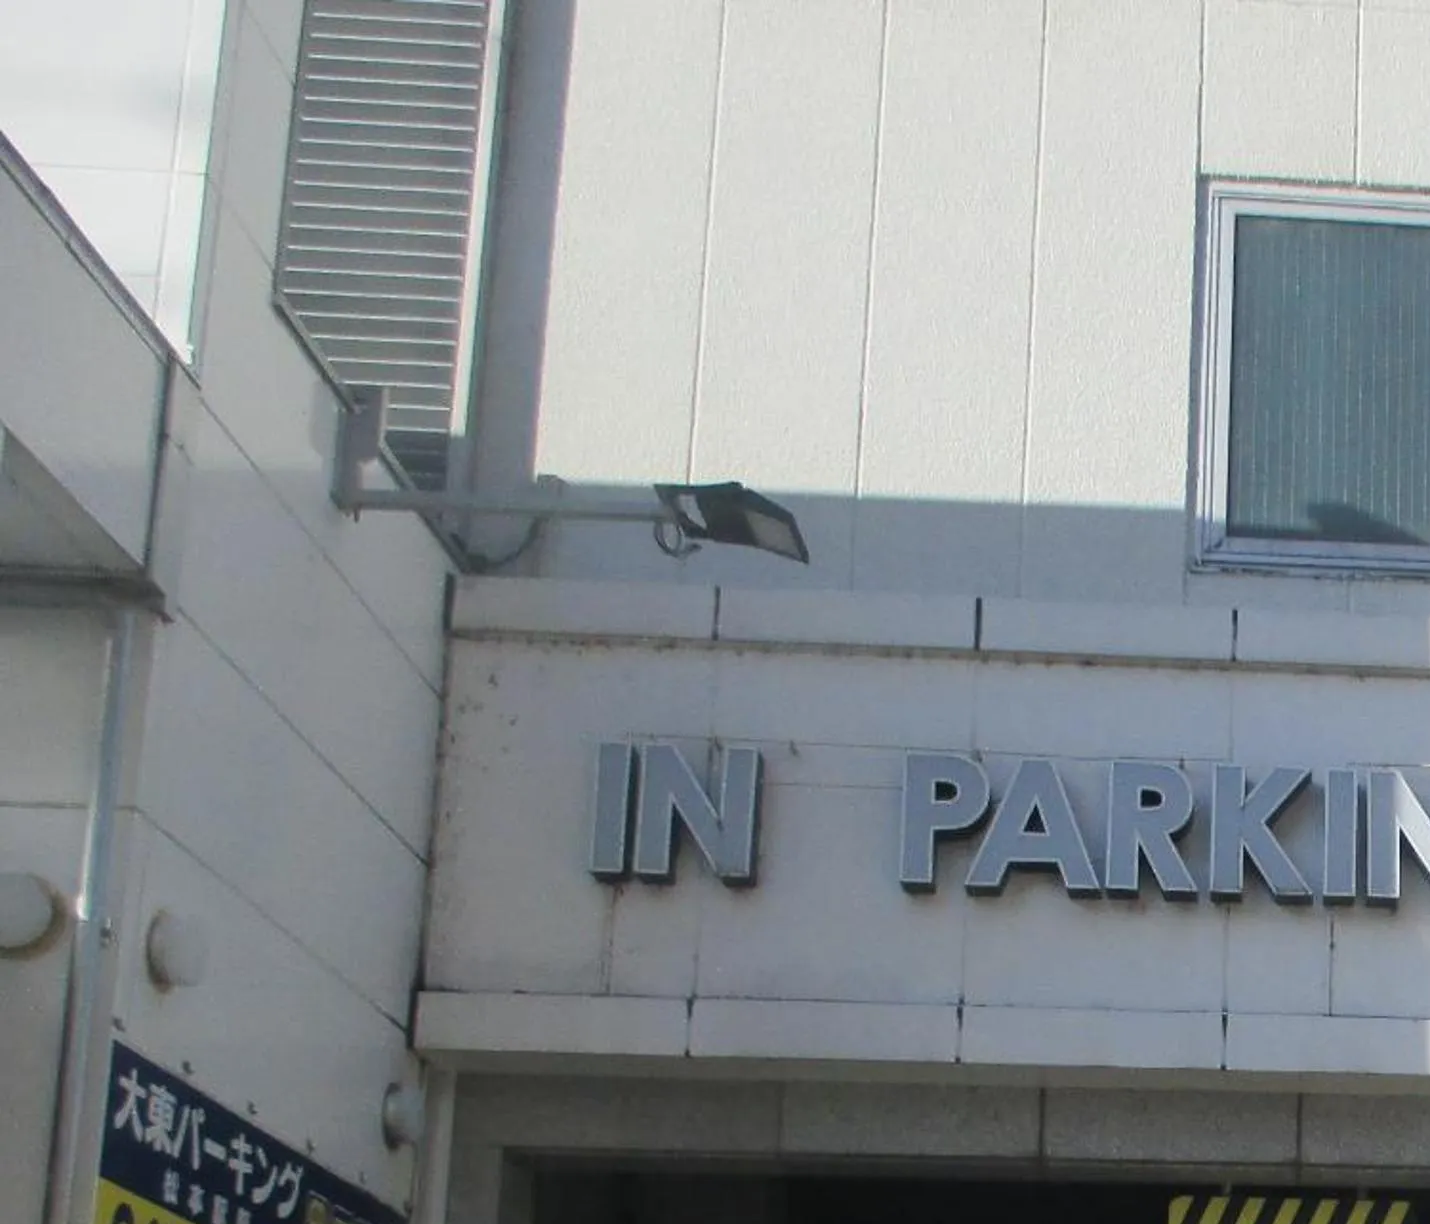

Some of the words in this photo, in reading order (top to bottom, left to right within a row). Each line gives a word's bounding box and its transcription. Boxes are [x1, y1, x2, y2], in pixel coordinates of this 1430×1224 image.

[590, 741, 764, 886] IN
[113, 1067, 304, 1219] 大東パーキング
